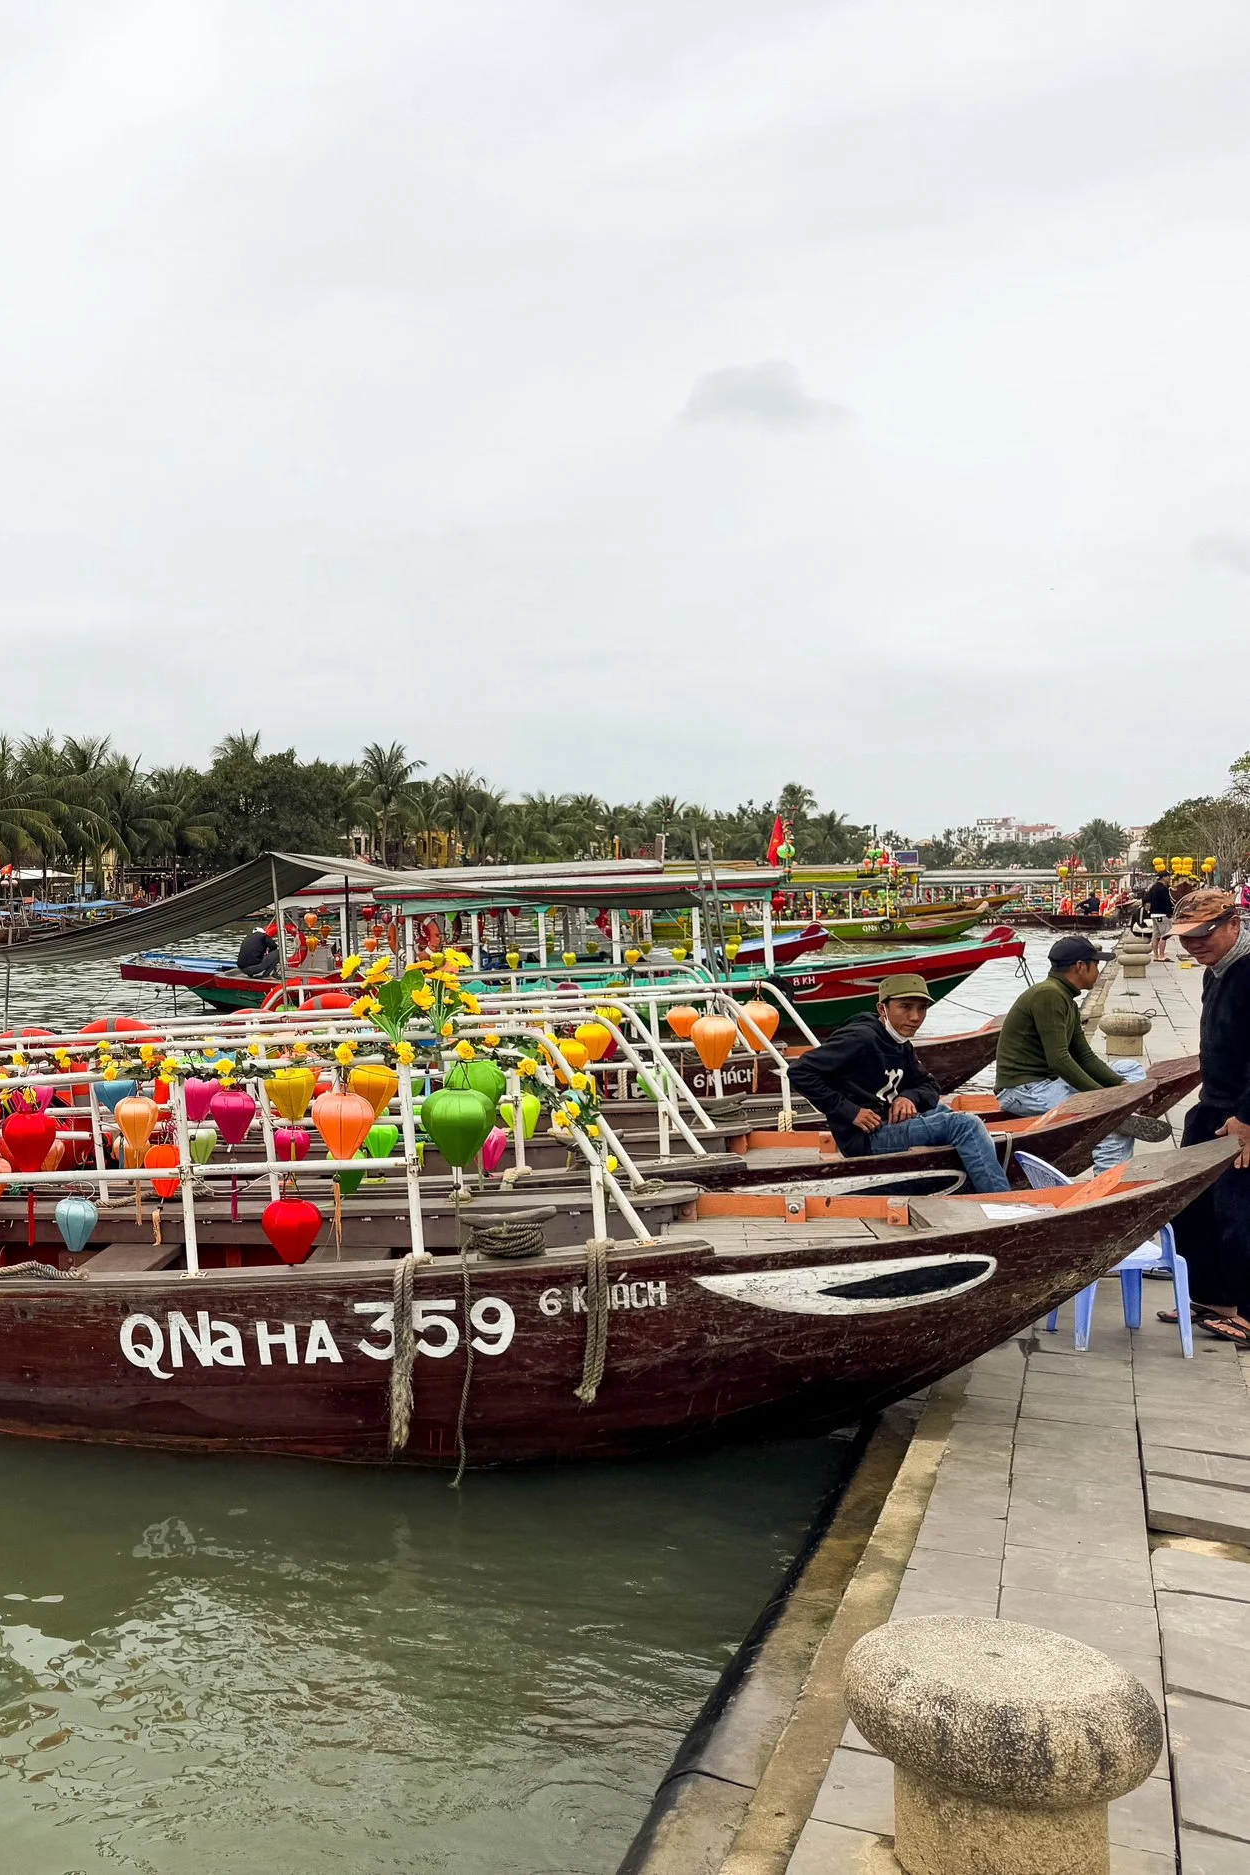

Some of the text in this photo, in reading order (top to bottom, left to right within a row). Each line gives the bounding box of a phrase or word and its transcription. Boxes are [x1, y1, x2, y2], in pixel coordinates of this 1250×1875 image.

[793, 975, 816, 986] 8 KH
[693, 1073, 705, 1089] 6
[538, 1272, 668, 1316] 6 KÁCH
[119, 1296, 516, 1380] QNa HA 359
